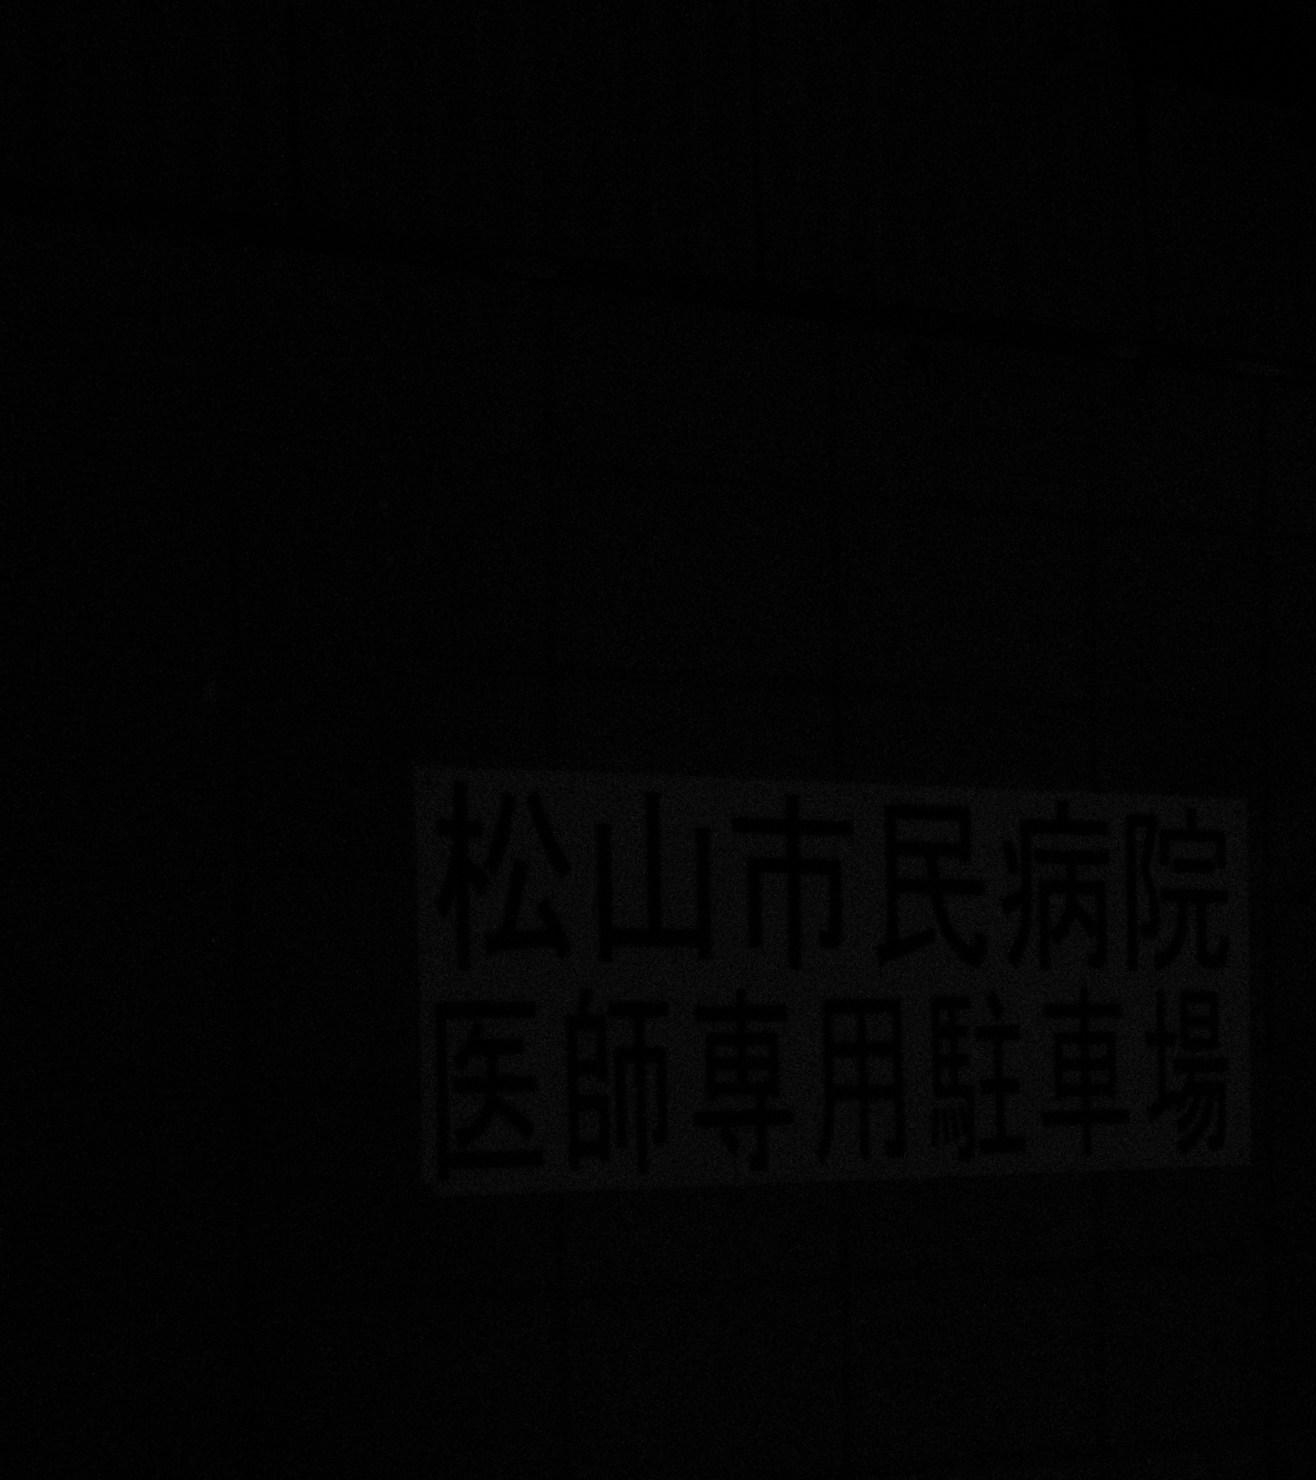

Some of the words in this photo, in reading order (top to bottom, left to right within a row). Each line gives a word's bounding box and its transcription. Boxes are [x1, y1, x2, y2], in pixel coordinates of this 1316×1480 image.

[434, 780, 1230, 971] 松山市民病院
[434, 987, 1229, 1181] 医師専用駐車場
